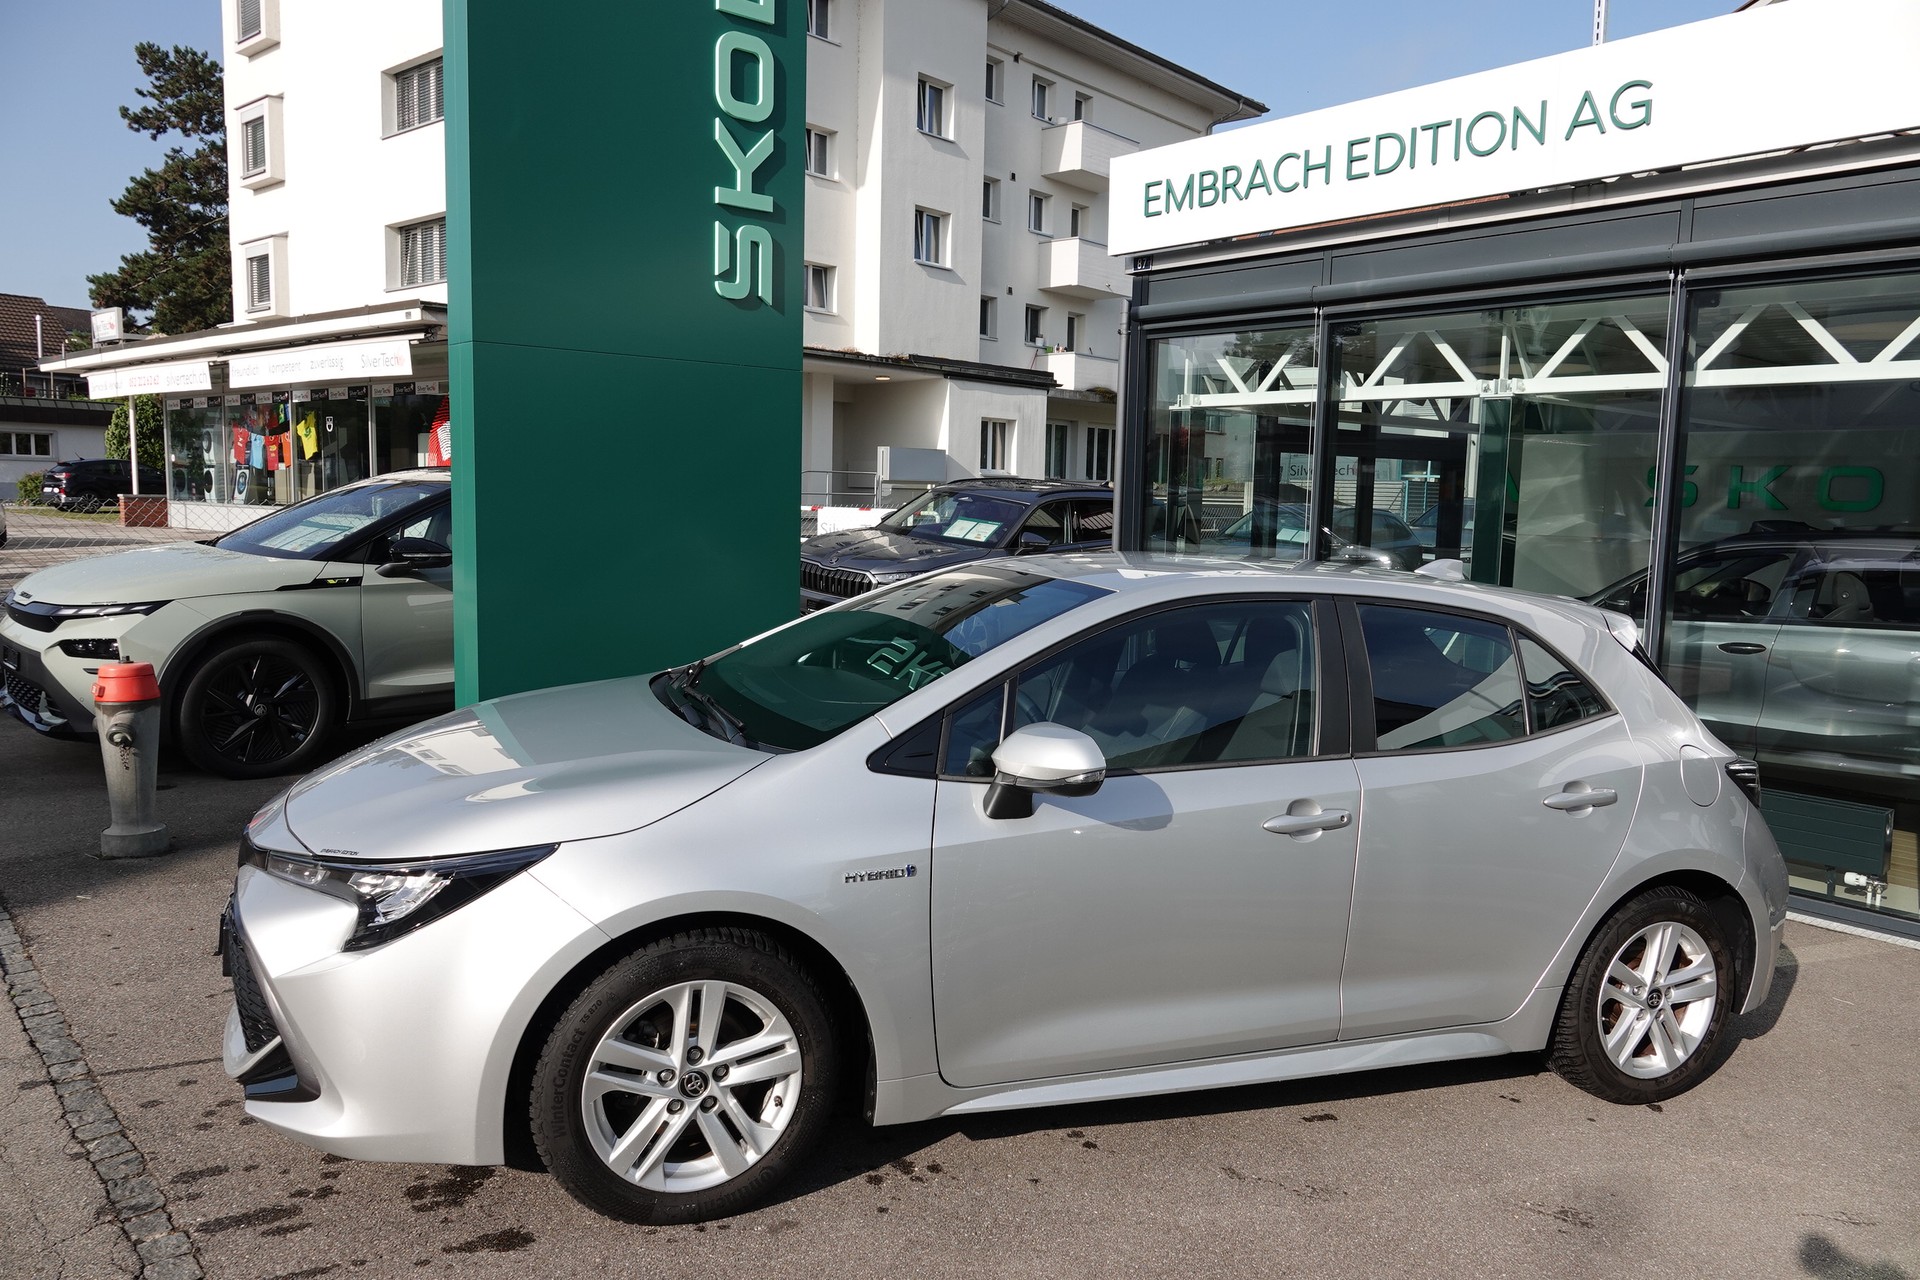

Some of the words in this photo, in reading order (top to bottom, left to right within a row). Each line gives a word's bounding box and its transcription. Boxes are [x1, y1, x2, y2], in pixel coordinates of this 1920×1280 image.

[1144, 145, 1331, 218] EMBRACH
[1346, 99, 1548, 181] EDITION
[1565, 79, 1653, 141] AG
[1137, 258, 1147, 270] 87
[360, 352, 399, 369] SilverTech
[844, 868, 905, 883] HYBRID
[551, 1027, 586, 1141] WinterContact
[579, 1013, 591, 1024] TS
[588, 999, 603, 1014] 870
